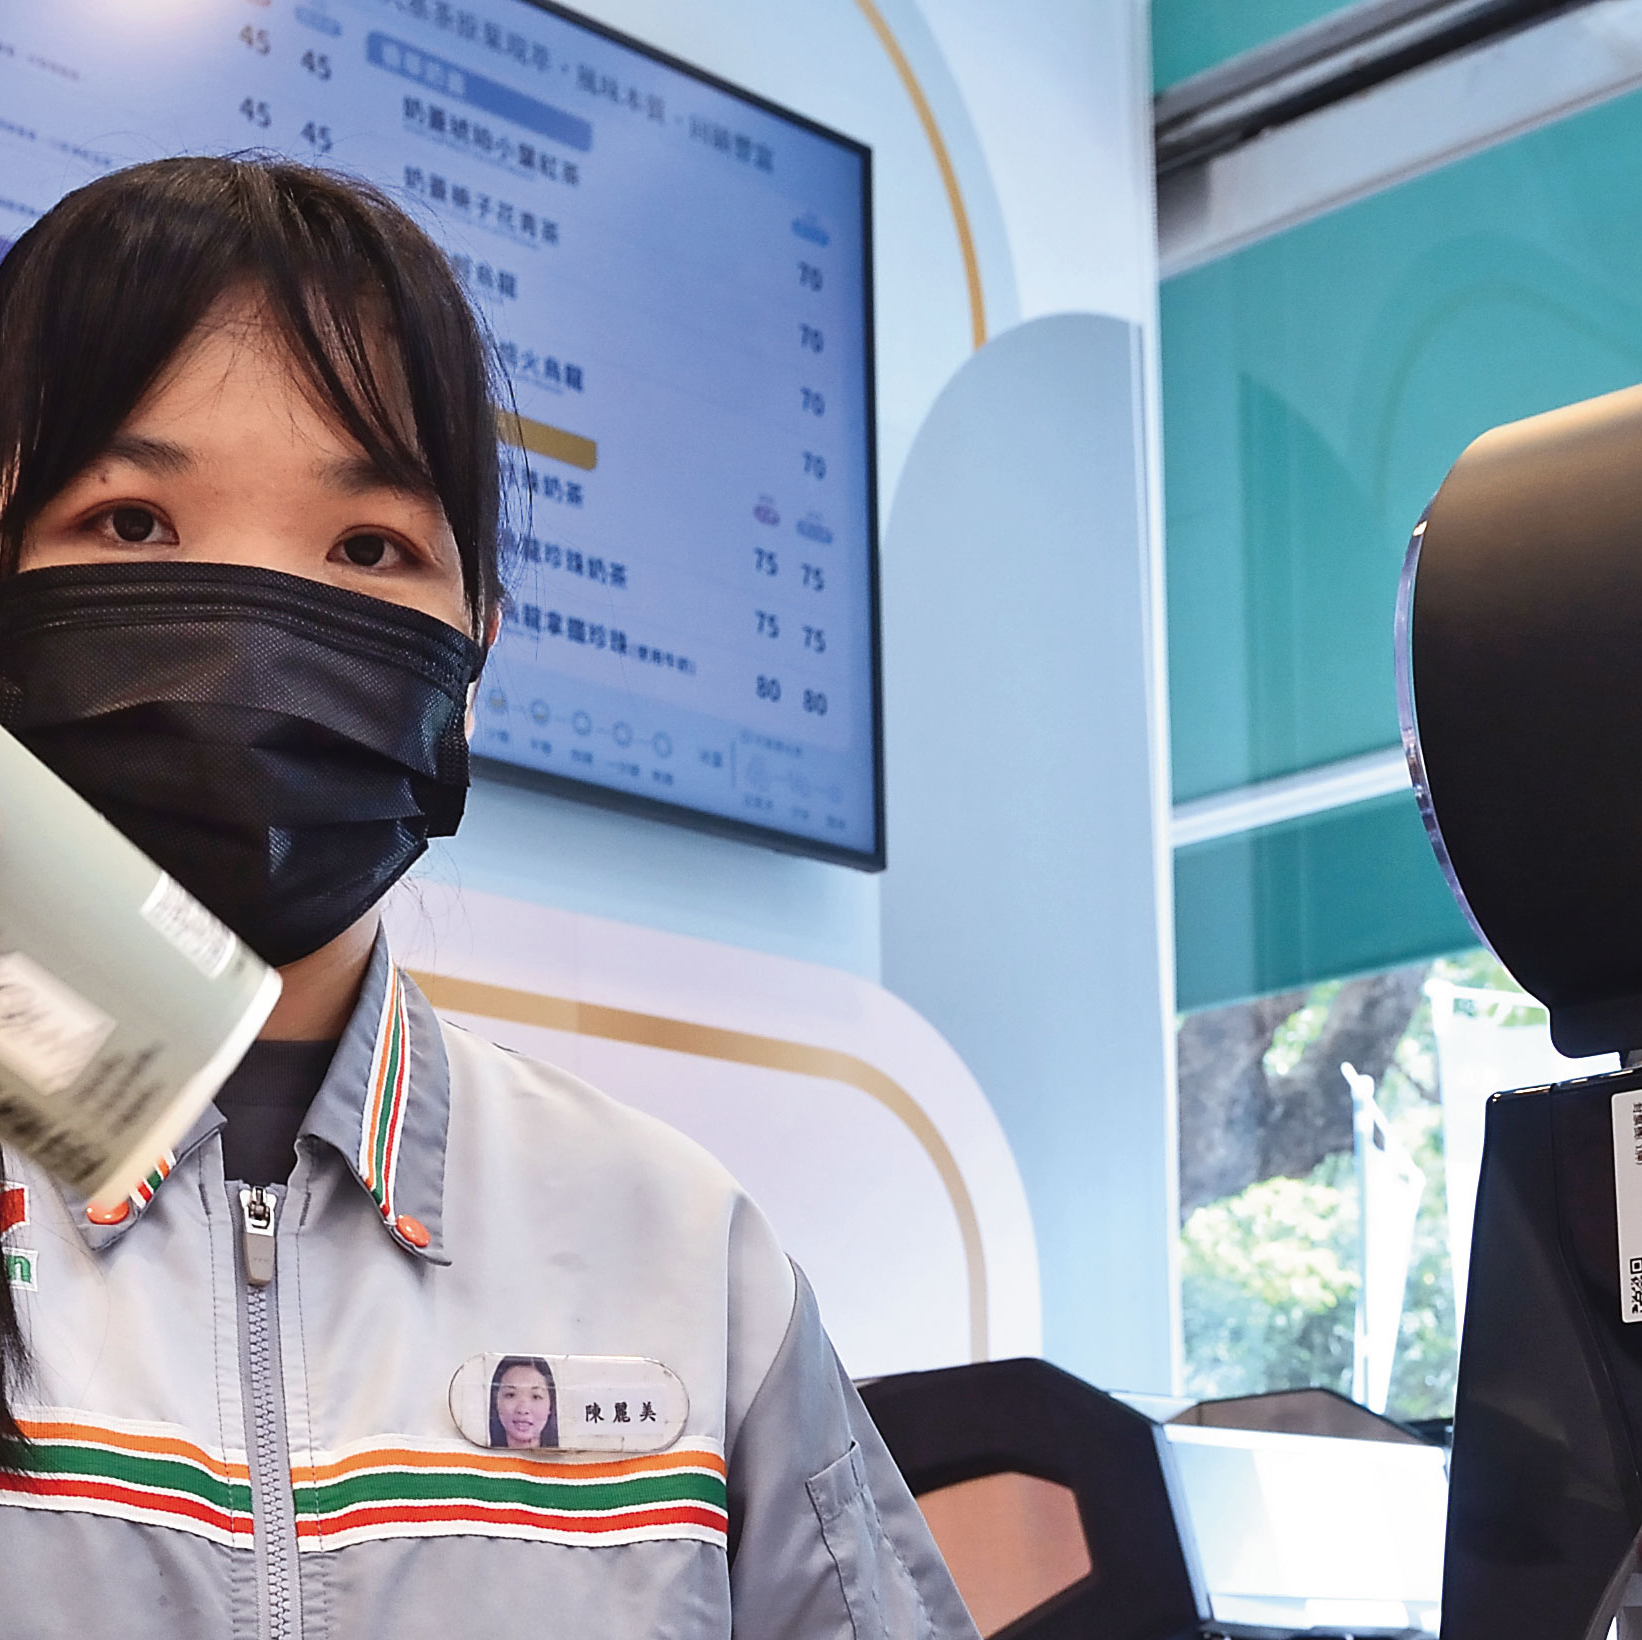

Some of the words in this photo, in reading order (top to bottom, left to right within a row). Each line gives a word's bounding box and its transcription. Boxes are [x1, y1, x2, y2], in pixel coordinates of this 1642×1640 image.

[240, 24, 271, 55] 45
[301, 50, 332, 81] 45
[240, 97, 272, 128] 45
[301, 121, 333, 153] 45
[797, 261, 823, 292] 70
[798, 323, 824, 354] 70
[799, 386, 826, 417] 70
[802, 450, 827, 481] 70
[754, 547, 779, 577] 75
[801, 563, 825, 592] 75
[755, 610, 780, 639] 75
[802, 625, 827, 653] 75
[755, 674, 782, 702] 80
[802, 688, 828, 717] 80
[585, 1401, 657, 1424] 陳麗美
